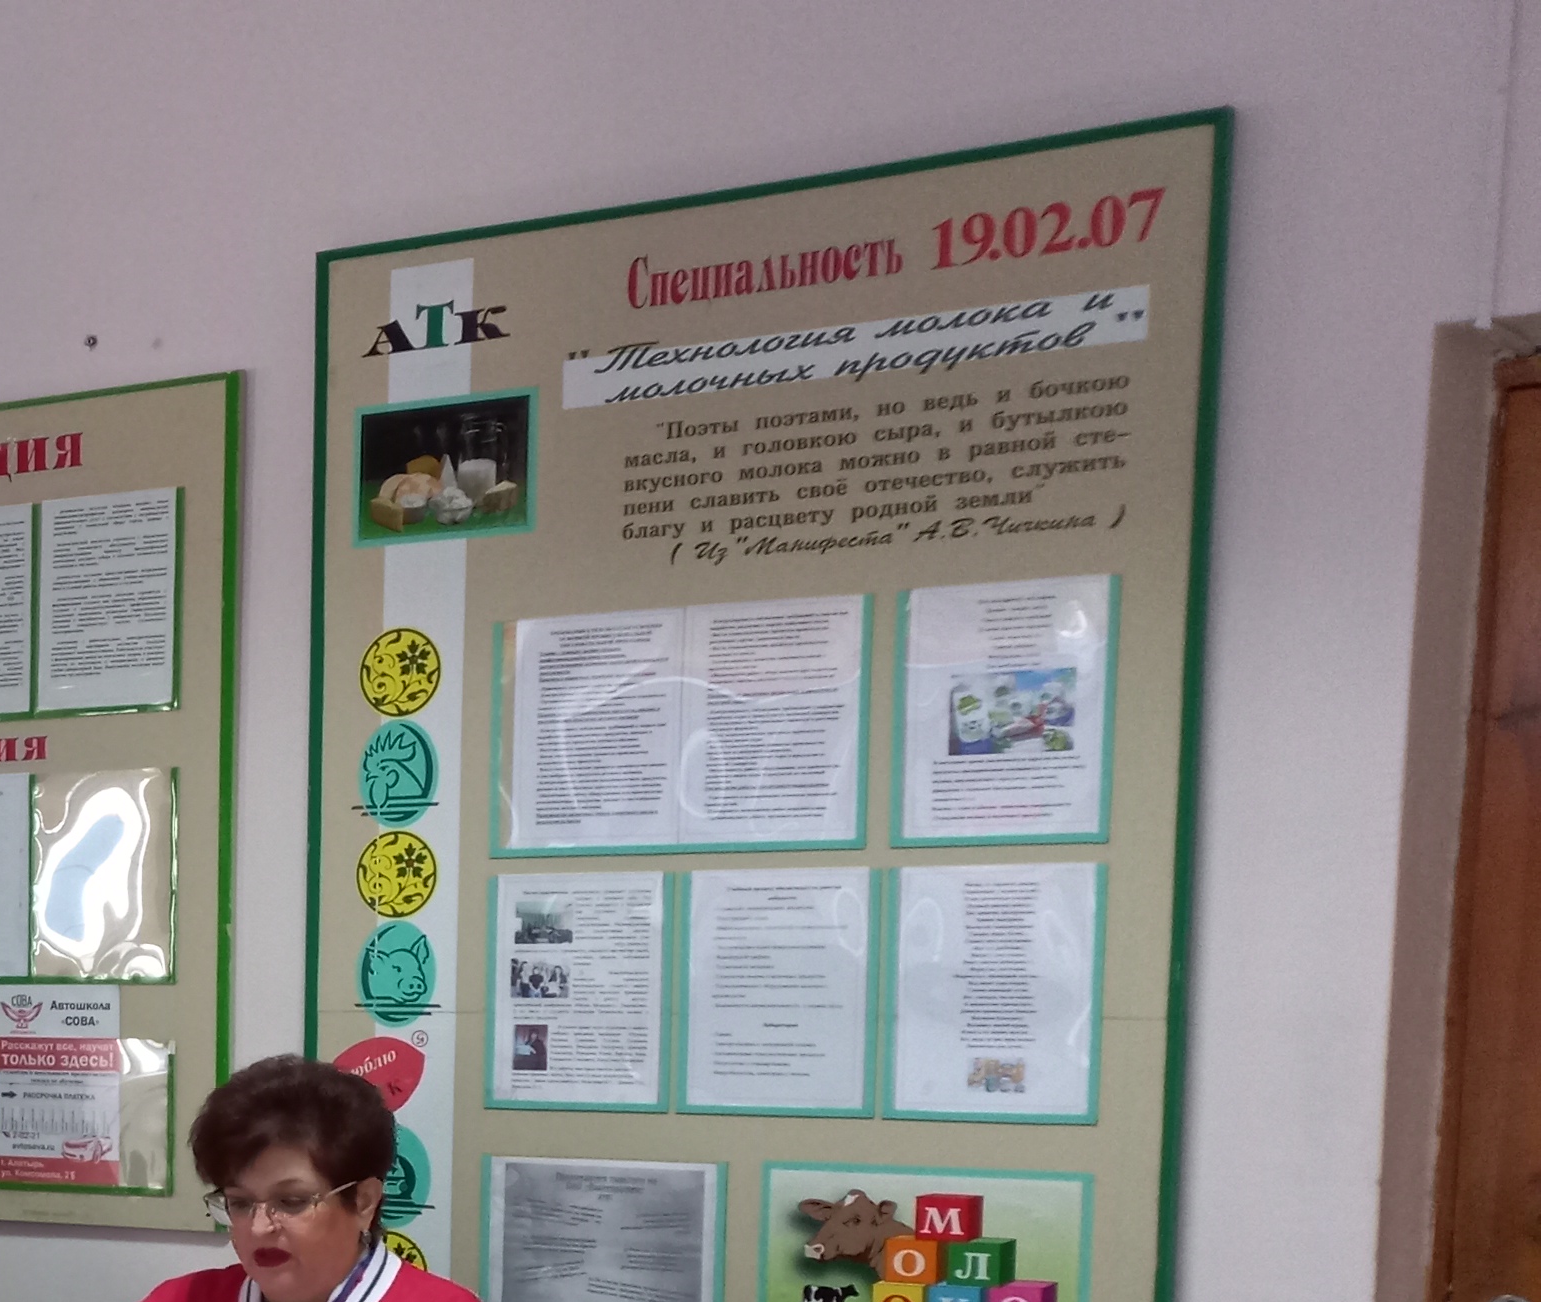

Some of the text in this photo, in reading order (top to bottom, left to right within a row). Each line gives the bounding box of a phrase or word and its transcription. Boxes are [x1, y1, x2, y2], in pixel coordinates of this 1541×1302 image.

[627, 186, 1167, 310] Специальность 19.02.07
[361, 299, 511, 358] АТК
[874, 297, 1054, 340] молока
[1082, 289, 1116, 312] и
[604, 363, 815, 404] молочных
[754, 404, 860, 430] поэтами,
[876, 399, 906, 417] но
[923, 392, 979, 412] ведь
[996, 388, 1012, 404] и
[1029, 373, 1131, 399] бочкою
[623, 400, 1129, 470] масла, и головкою сыра, и бутылкою
[623, 469, 723, 494] вкусного
[739, 459, 823, 481] молока
[839, 449, 921, 471] можно
[937, 446, 951, 462] в
[968, 430, 1057, 463] равной
[623, 453, 1127, 517] пени славить своё отечество, служить
[621, 519, 686, 541] благу
[700, 518, 714, 534] и
[729, 507, 835, 535] расцвету
[851, 494, 938, 524] родной
[49, 1000, 111, 1011] Автошкола
[1, 1039, 54, 1051] Расскажут
